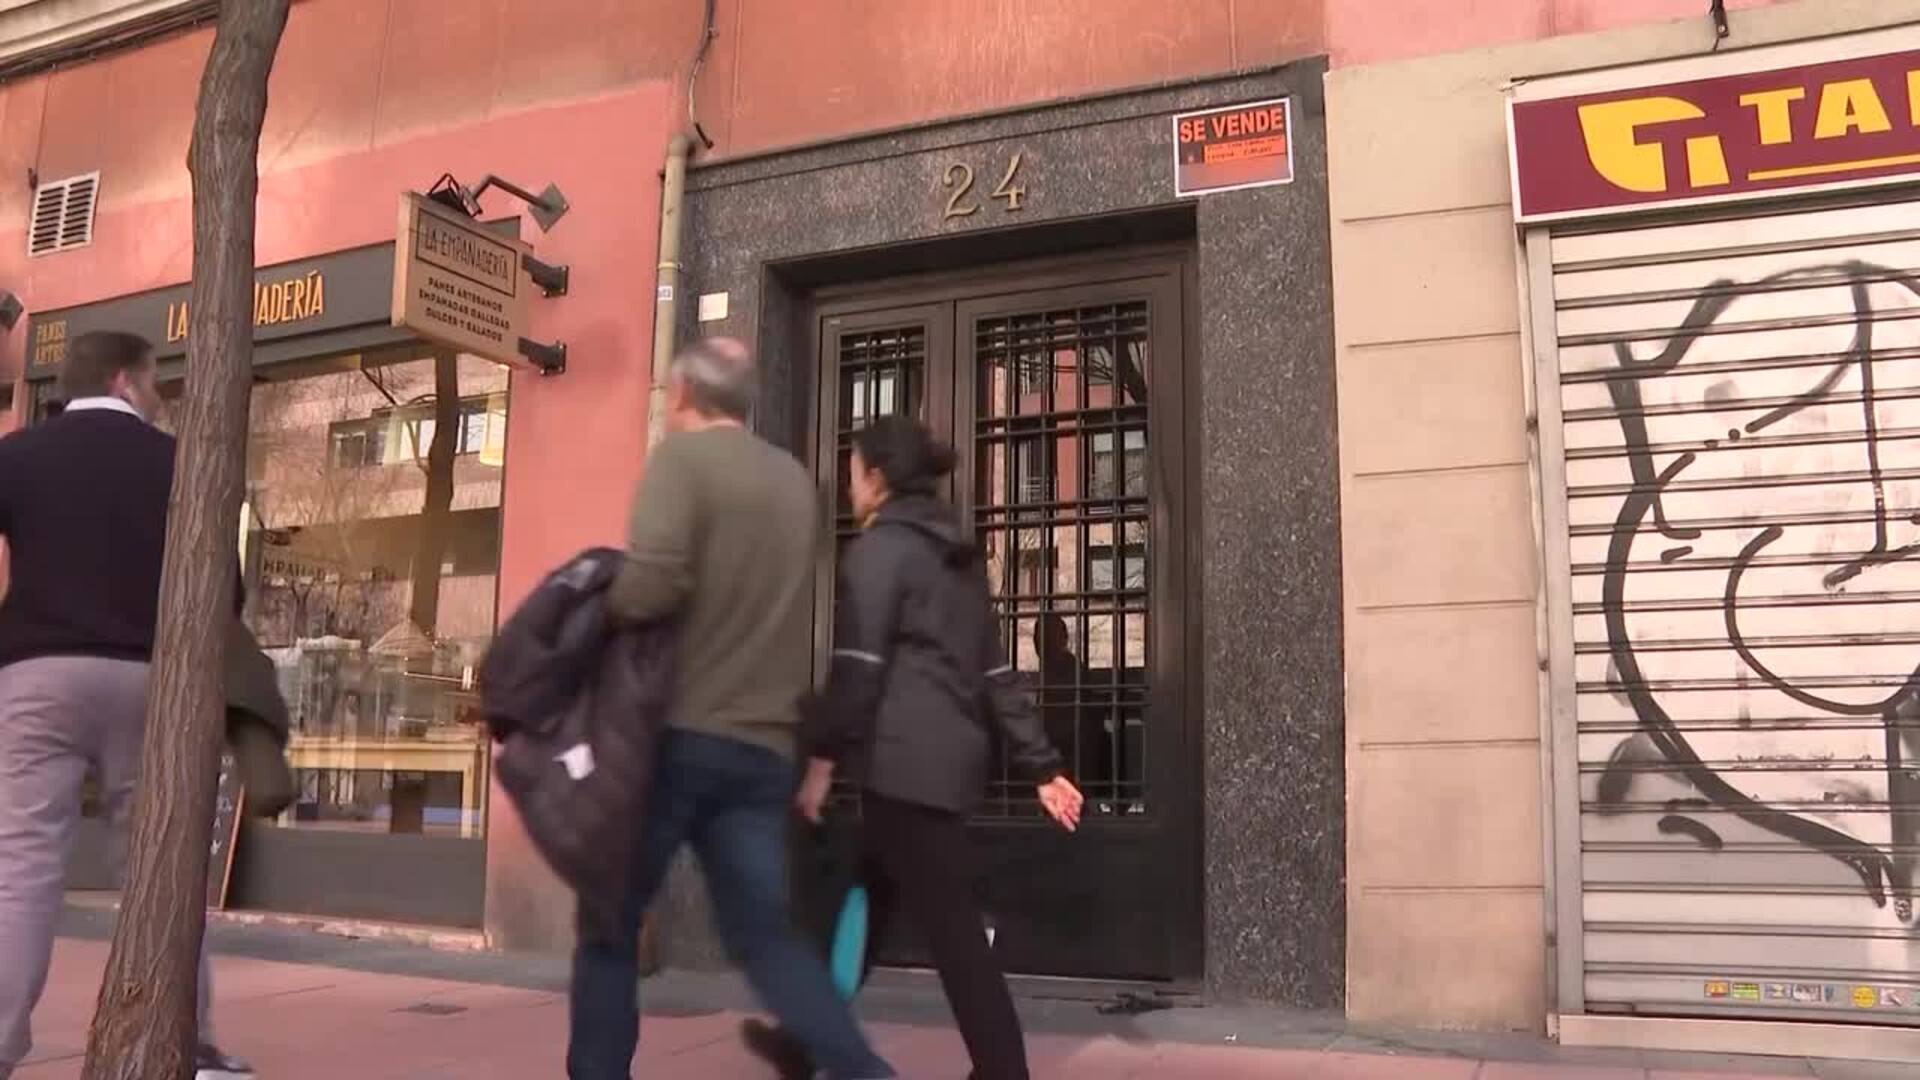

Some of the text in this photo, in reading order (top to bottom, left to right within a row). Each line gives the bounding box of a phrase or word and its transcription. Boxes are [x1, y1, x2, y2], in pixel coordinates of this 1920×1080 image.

[1180, 107, 1283, 143] SE VENDE
[1739, 69, 1920, 145] TA
[943, 153, 1026, 220] 24
[425, 228, 437, 253] LA
[419, 288, 510, 331] EMPANADAS GALLEGAS
[428, 277, 503, 313] PANES ARTESANOS
[167, 301, 188, 342] LA
[426, 306, 458, 326] DULCES
[467, 321, 502, 342] SALADOS
